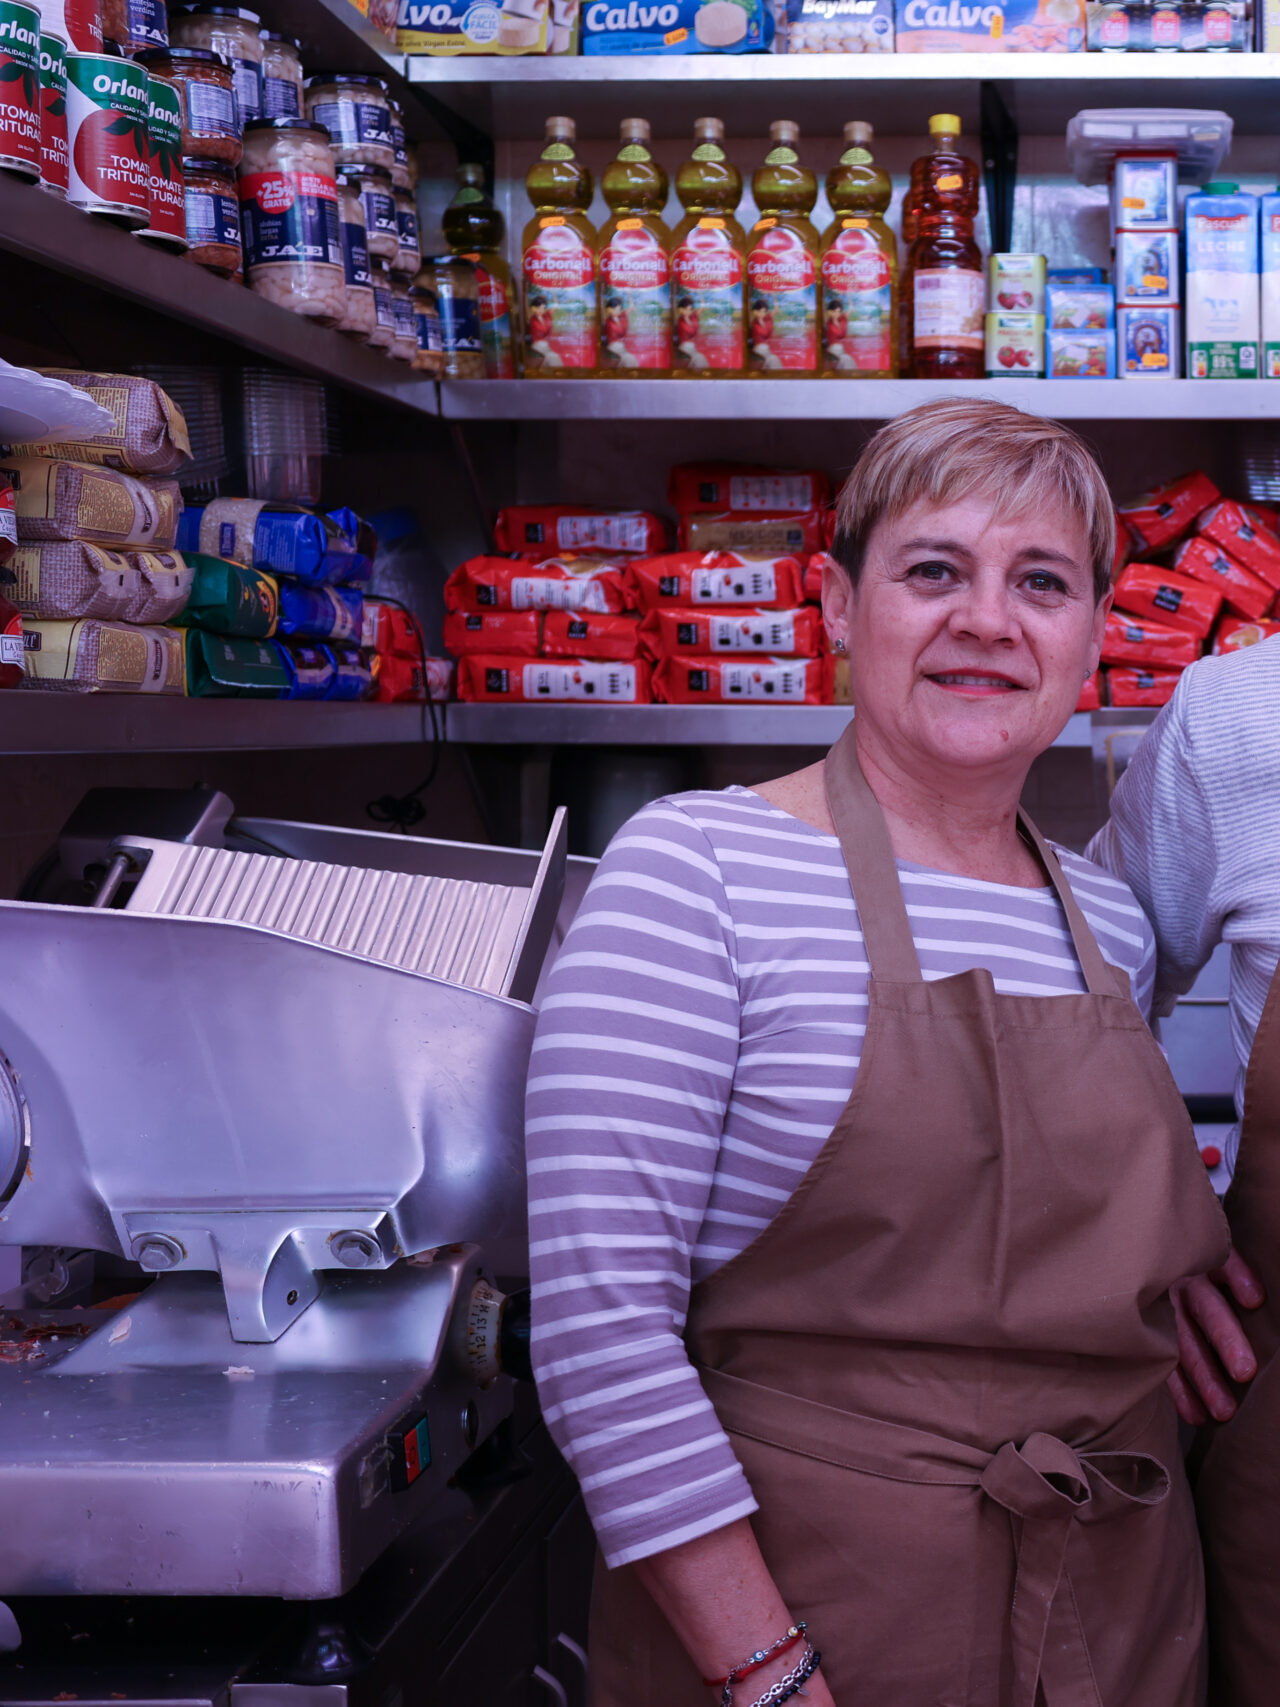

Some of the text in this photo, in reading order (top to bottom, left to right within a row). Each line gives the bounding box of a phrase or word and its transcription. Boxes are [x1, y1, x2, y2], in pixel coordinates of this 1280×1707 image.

[586, 1, 679, 32] Calvo
[904, 1, 1003, 27] Calvo
[110, 103, 136, 112] CALIDAD
[263, 198, 291, 208] GRATIS
[1198, 216, 1248, 229] Pascual
[1197, 241, 1247, 252] LECHE
[525, 257, 592, 272] Carbonell
[600, 258, 667, 273] Carbonell
[672, 258, 739, 273] Carbonell
[748, 259, 812, 275] Carbonell
[823, 260, 887, 275] Carbonell
[477, 1318, 488, 1330] 13
[475, 1335, 486, 1348] 12
